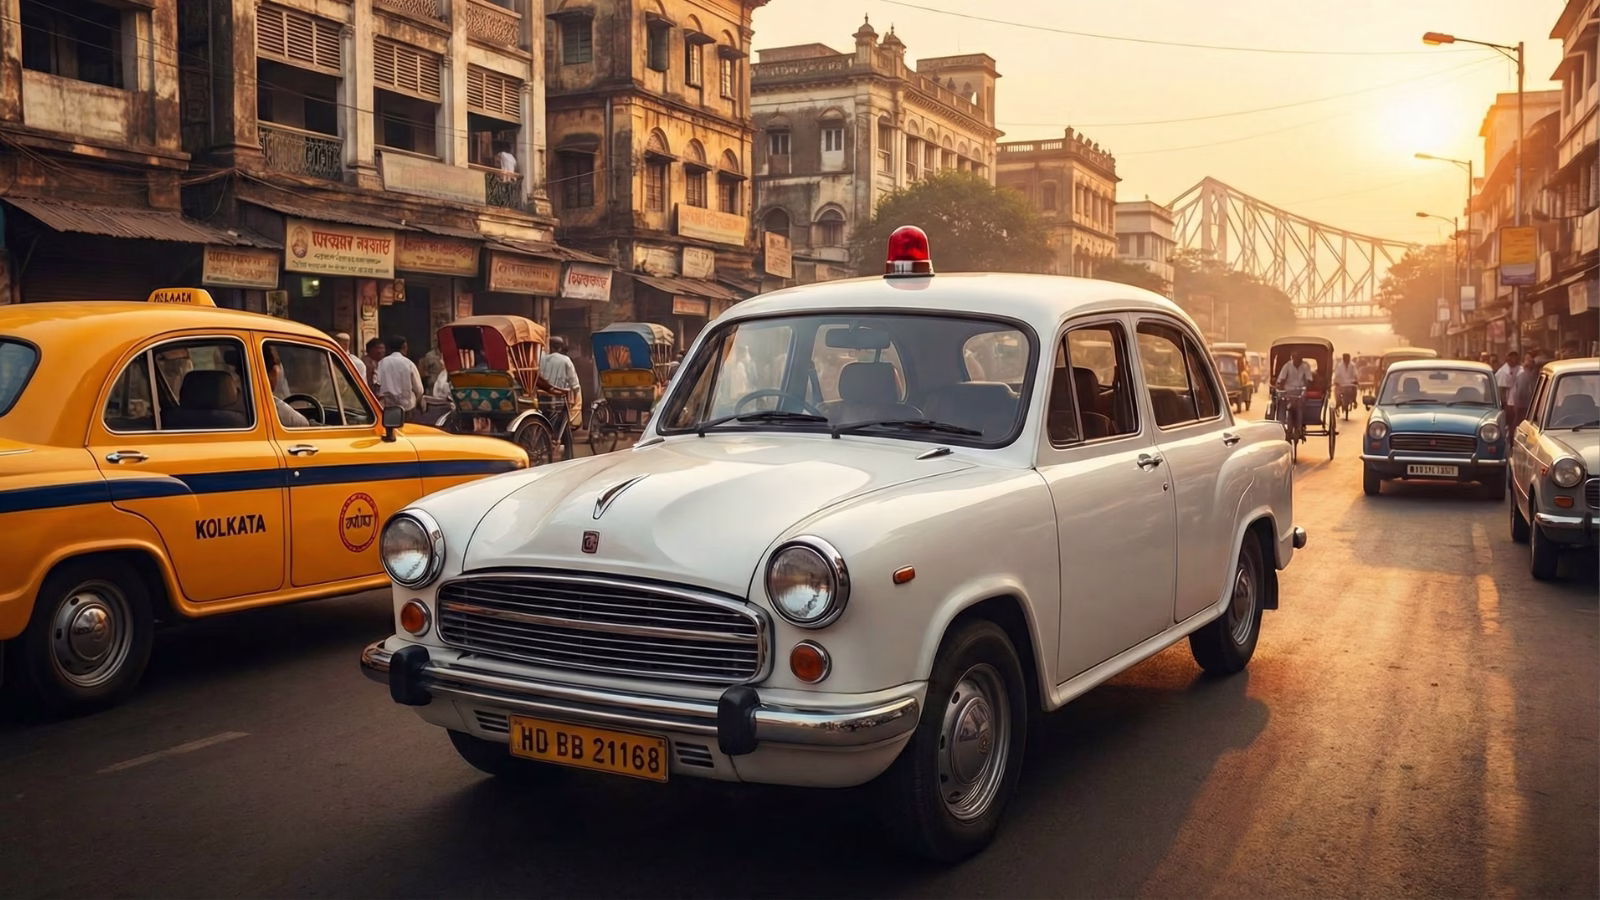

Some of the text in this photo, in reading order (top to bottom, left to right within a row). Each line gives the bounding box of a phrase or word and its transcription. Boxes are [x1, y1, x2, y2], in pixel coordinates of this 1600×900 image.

[195, 514, 267, 540] KOLKATA
[521, 726, 660, 773] HD BB 21168
